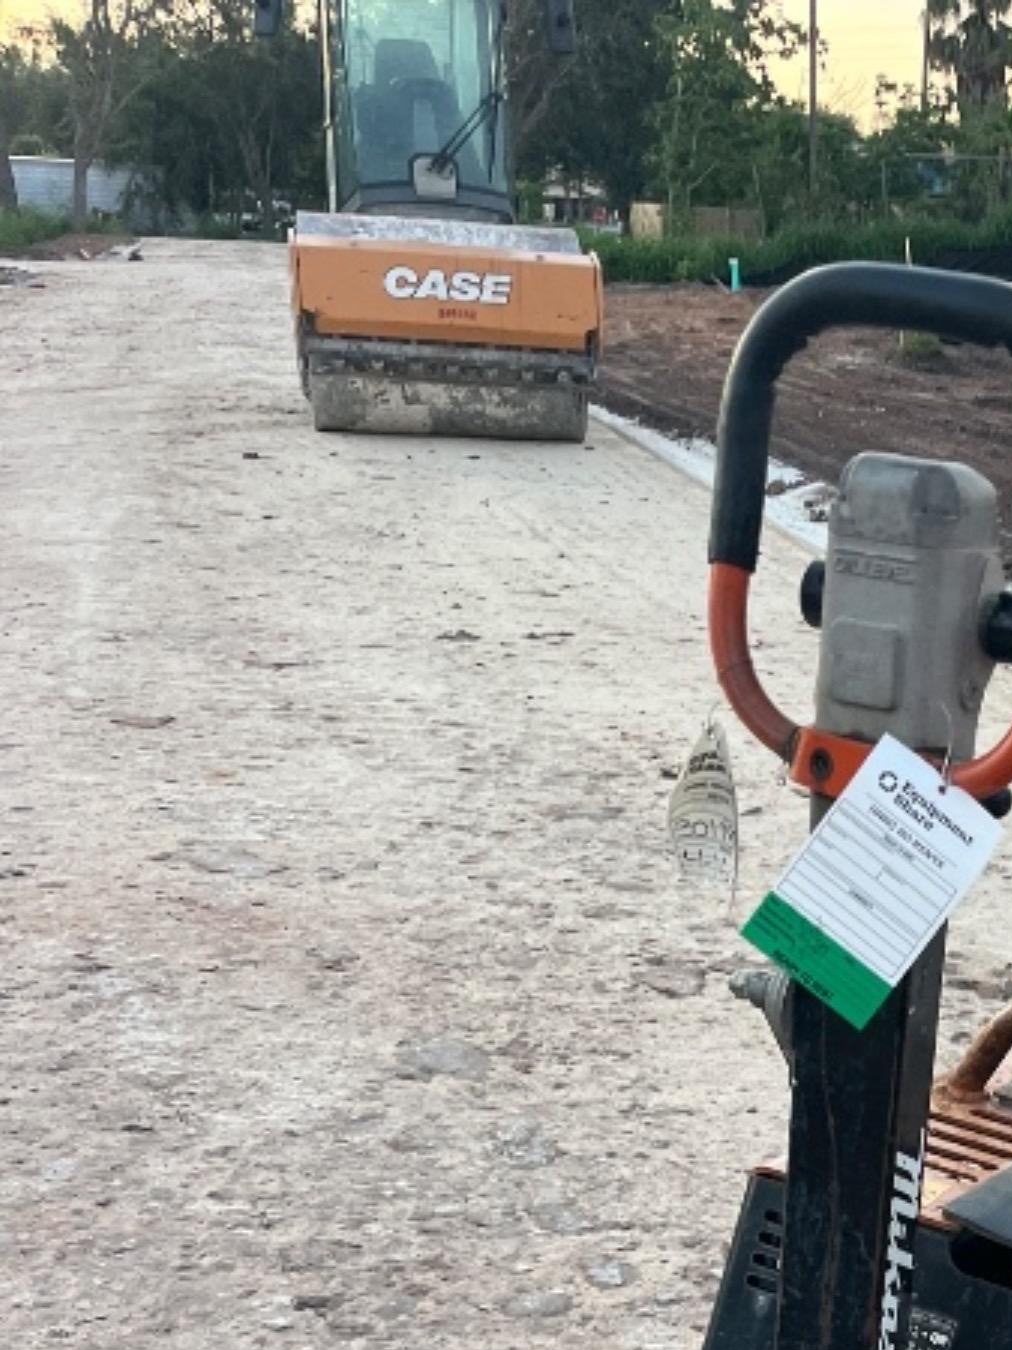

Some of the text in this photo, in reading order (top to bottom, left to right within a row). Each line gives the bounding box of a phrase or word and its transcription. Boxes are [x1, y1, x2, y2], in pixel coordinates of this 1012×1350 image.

[384, 266, 513, 305] CASE
[894, 794, 933, 831] Share
[902, 781, 973, 846] Equipment
